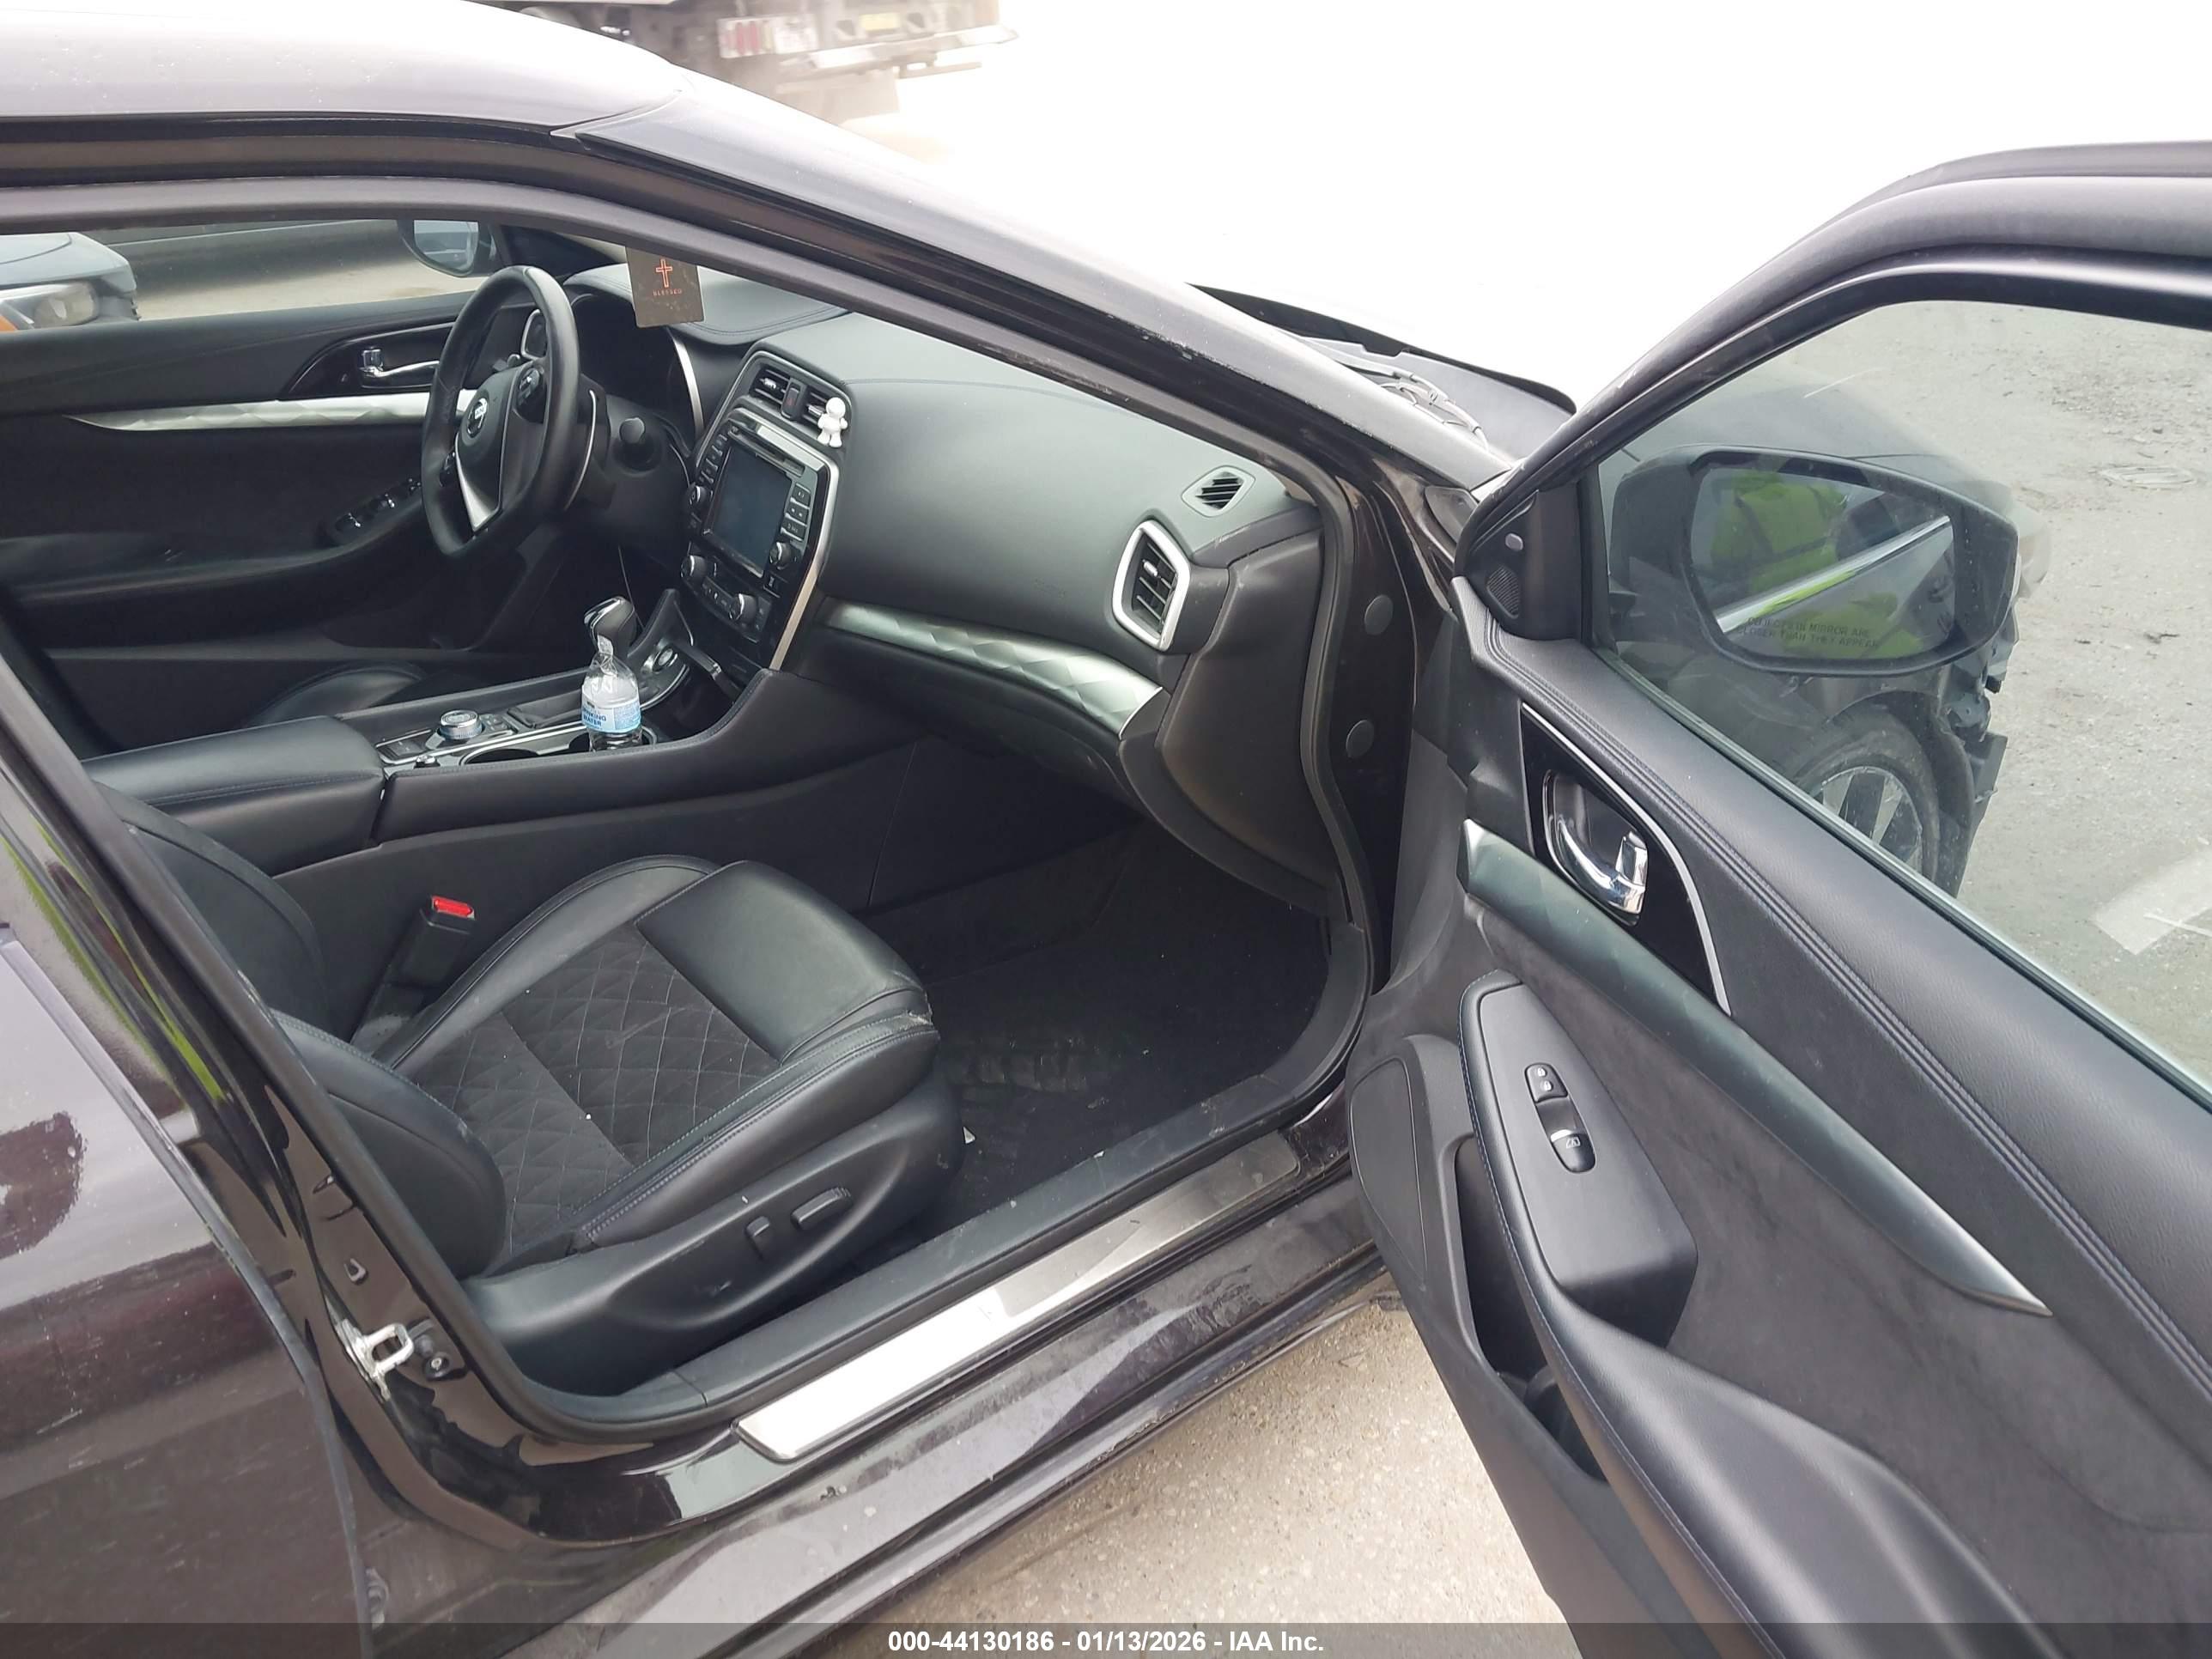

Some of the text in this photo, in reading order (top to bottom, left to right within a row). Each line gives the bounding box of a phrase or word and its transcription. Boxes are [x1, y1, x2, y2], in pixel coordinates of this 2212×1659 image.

[1780, 629, 1806, 641] THAN
[1809, 624, 1847, 635] MIRROR
[584, 714, 602, 726] WATER
